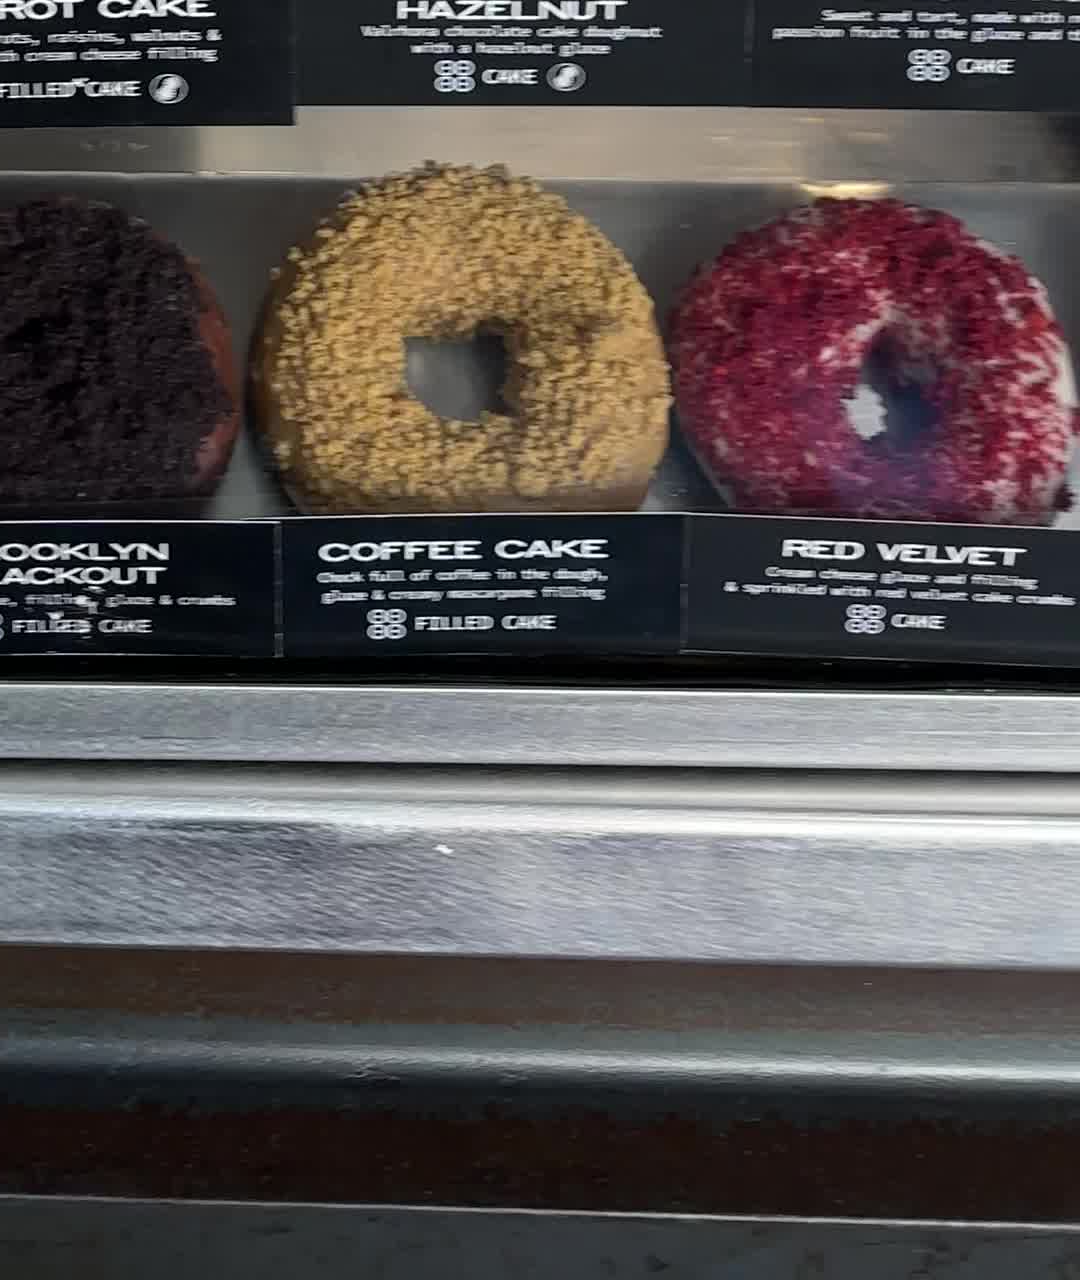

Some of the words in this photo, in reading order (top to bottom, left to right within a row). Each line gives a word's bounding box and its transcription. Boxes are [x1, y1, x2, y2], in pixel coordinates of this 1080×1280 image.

[396, 0, 628, 21] HAZELNUT
[956, 58, 1016, 74] CAKE
[481, 69, 538, 85] CAKE
[85, 81, 143, 97] CAKE
[319, 540, 483, 562] COFFEE
[494, 538, 609, 559] CAKE
[781, 539, 866, 560] RED
[876, 542, 1028, 566] VELVET
[98, 619, 152, 633] CAKE
[414, 616, 494, 631] FILLED
[502, 614, 558, 630] CAKE
[891, 614, 947, 630] CAKE
